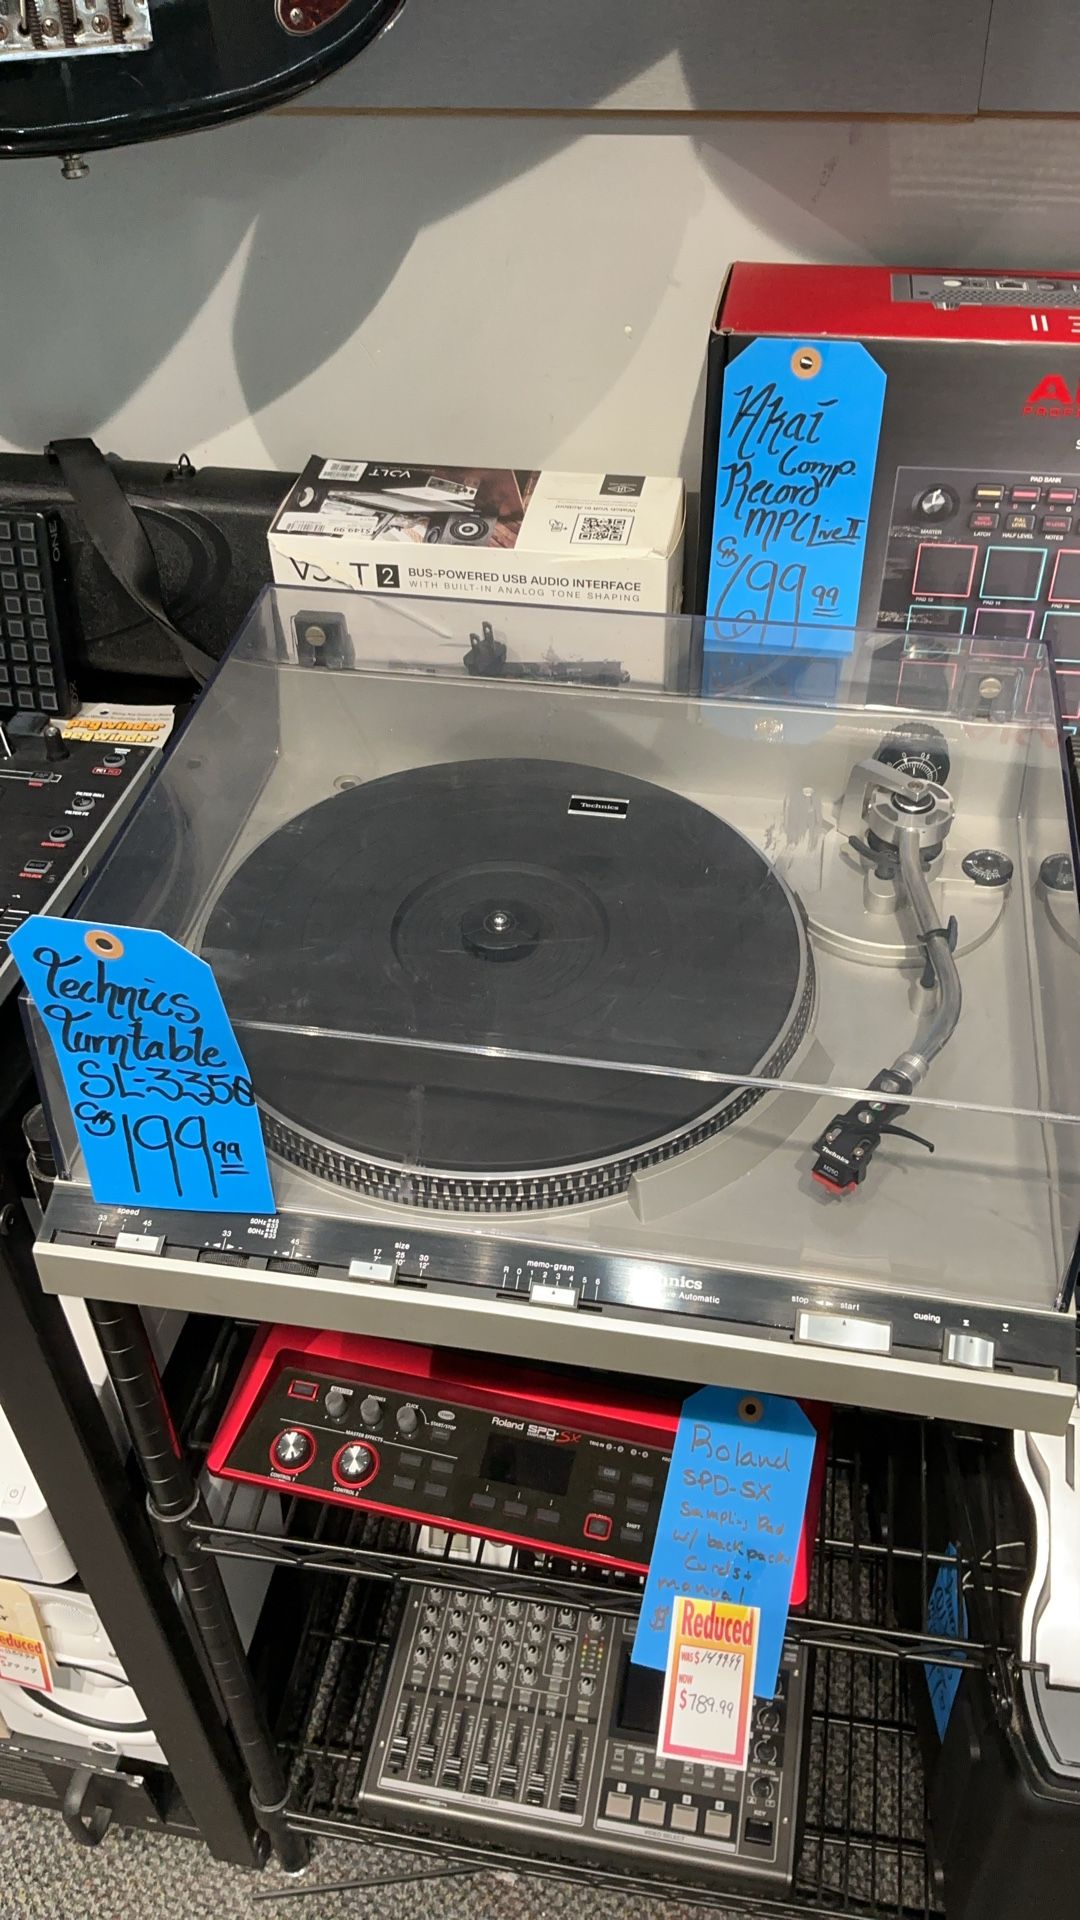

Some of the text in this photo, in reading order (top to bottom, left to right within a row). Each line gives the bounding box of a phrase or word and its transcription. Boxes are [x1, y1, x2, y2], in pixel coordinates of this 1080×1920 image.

[1025, 373, 1080, 405] A
[727, 383, 838, 460] Akai
[382, 567, 395, 585] 2
[408, 567, 641, 592] BUS-POWERED USB AUDIO INTERFACE
[409, 580, 640, 602] WITH BUILT-IN ANALOG TONE SHAPING
[66, 719, 165, 731] pegwinder
[580, 802, 619, 811] Technics
[33, 947, 201, 1024] Technics
[43, 1004, 228, 1071] Turntable
[821, 1145, 850, 1165] Technics
[117, 1208, 140, 1216] speed
[222, 1229, 232, 1237] 33
[394, 1242, 410, 1250] size
[527, 1260, 575, 1272] memo-gram
[679, 1291, 720, 1304] Automatic
[791, 1295, 860, 1311] stop start
[913, 1311, 941, 1324] cueing
[492, 1416, 525, 1431] Roland
[345, 1429, 384, 1442] MASTER EFFECTS
[691, 1423, 791, 1473] Roland
[683, 1468, 772, 1501] SPD-SX
[681, 1599, 755, 1645] Reduced
[0, 1633, 43, 1653] educed
[681, 1651, 693, 1662] WAS
[678, 1673, 693, 1685] NOW
